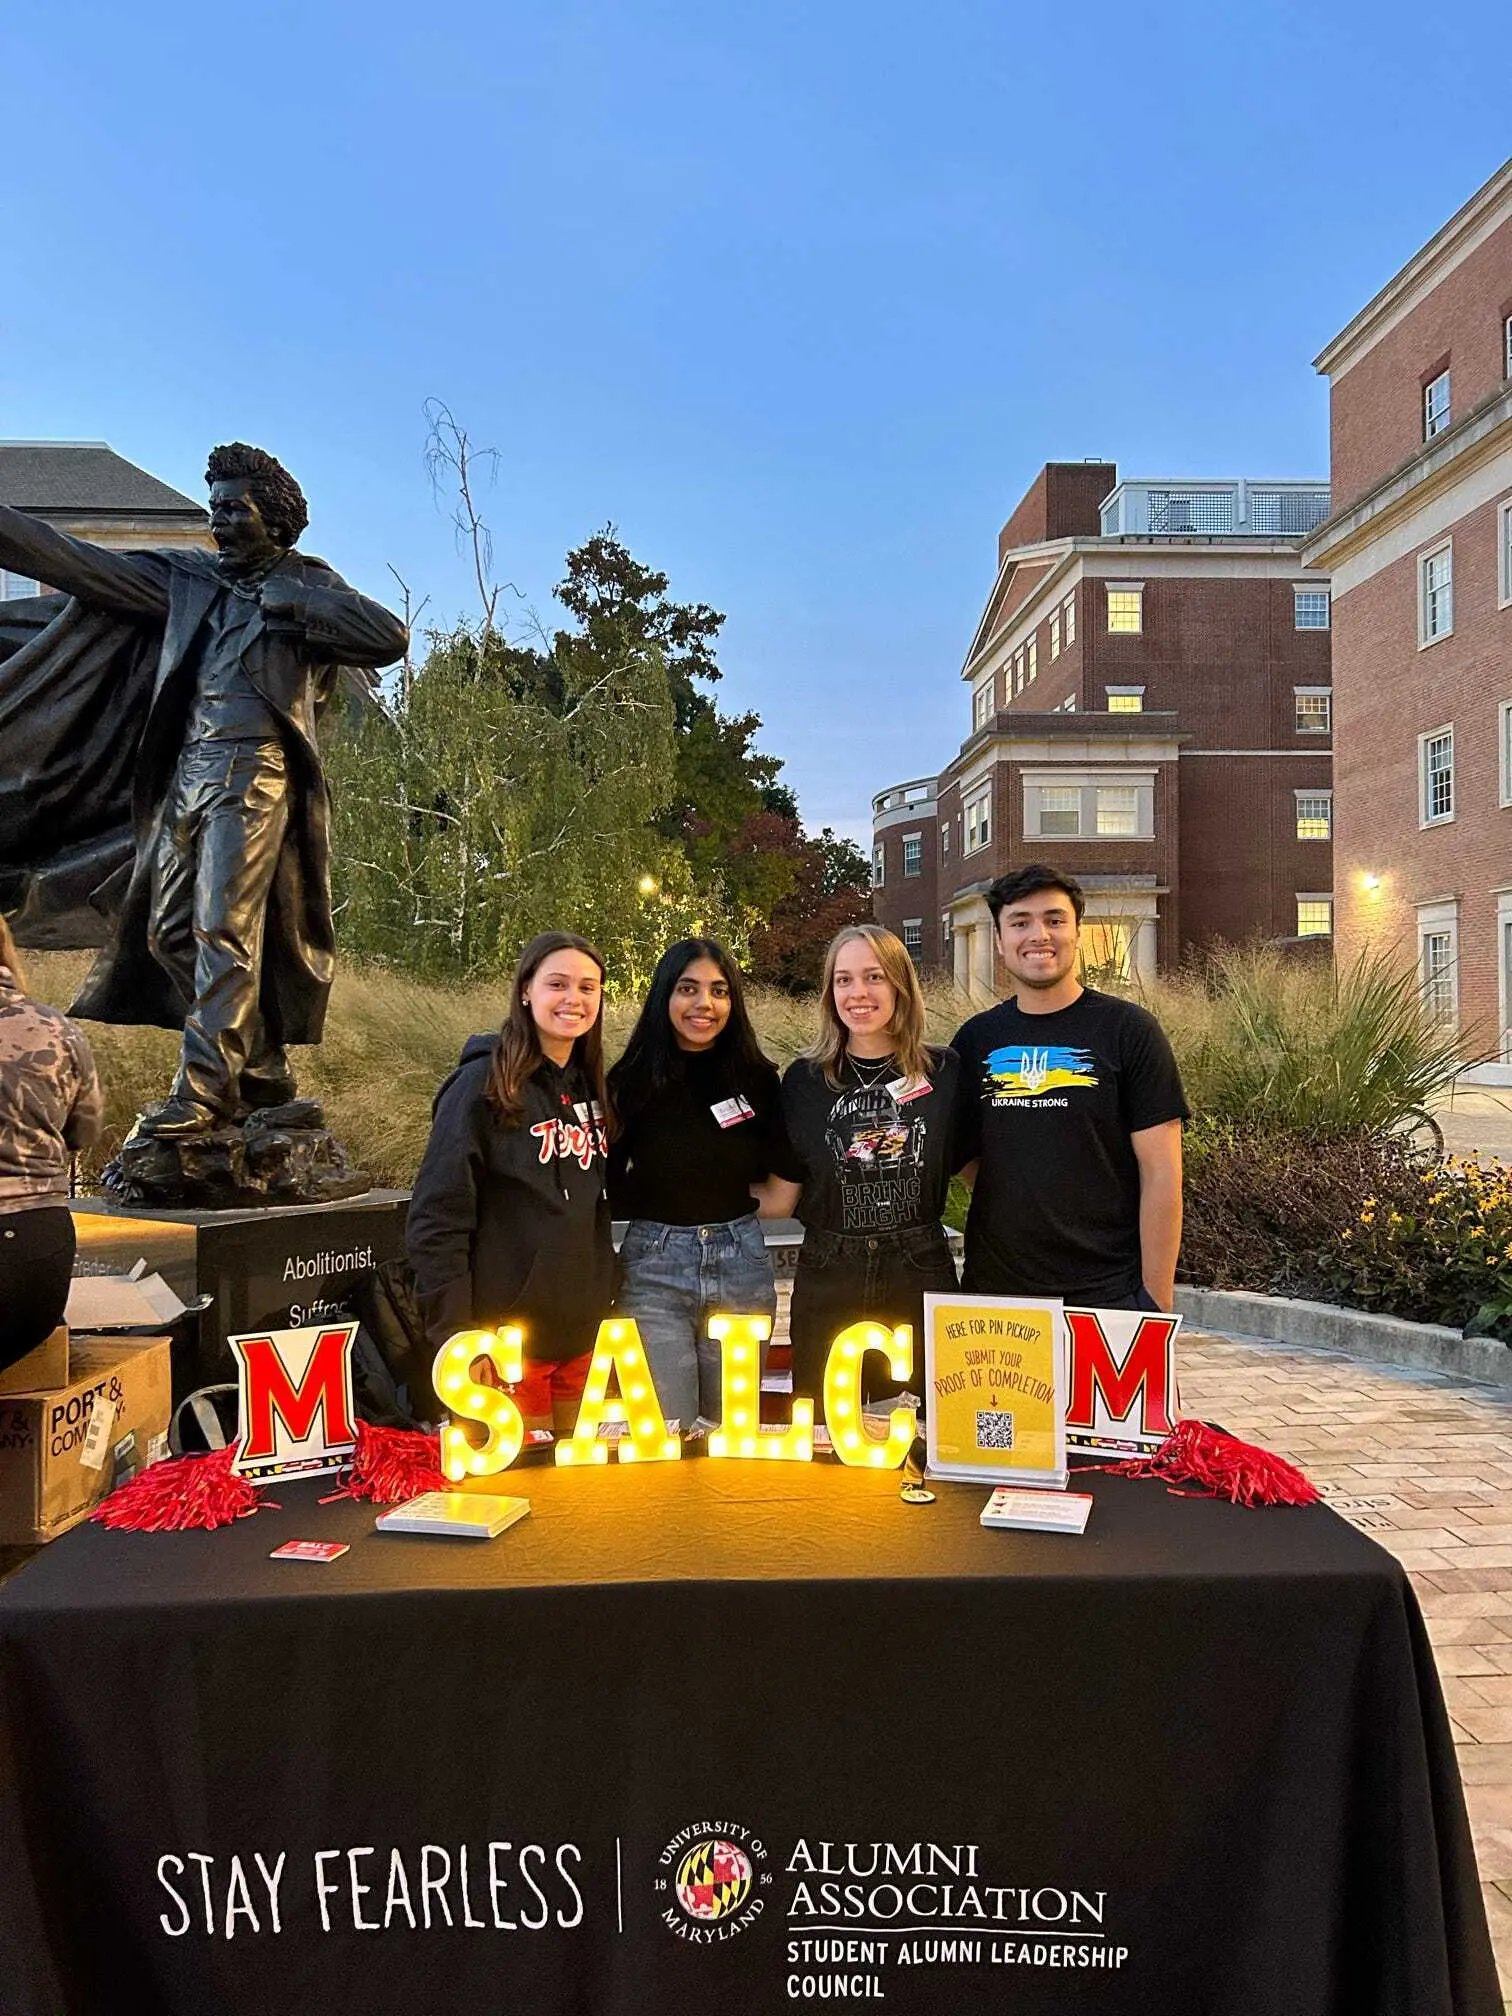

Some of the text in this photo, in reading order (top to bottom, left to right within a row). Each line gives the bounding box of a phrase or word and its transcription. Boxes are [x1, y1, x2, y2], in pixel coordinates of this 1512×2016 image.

[991, 1098, 1069, 1108] UKRAINE STRONG
[841, 1177, 921, 1207] BRING
[842, 1201, 921, 1230] NIGHT
[282, 1245, 377, 1282] Abolitionist,
[945, 1319, 1041, 1345] HERE FOR PIN PICKUP?
[964, 1349, 1023, 1369] SUBMIT YOUR
[1064, 1311, 1178, 1437] M
[235, 1328, 358, 1462] M
[432, 1314, 916, 1481] SALC
[933, 1368, 1056, 1404] PROOF OF COMPLETION
[52, 1382, 107, 1434] PORT
[109, 1376, 124, 1401] &
[660, 1820, 768, 1865] UNIVERSITY OF
[785, 1838, 979, 1878] ALUMNI
[157, 1842, 584, 1939] STAY FEARLESS
[654, 1873, 773, 1891] 18 56
[661, 1898, 765, 1944] MARYLAND
[786, 1881, 1108, 1924] ASSOCIATION
[787, 1939, 1129, 1969] STUDENT ALUMNI LEADERSHIP
[787, 1974, 885, 1999] COUNCIL
